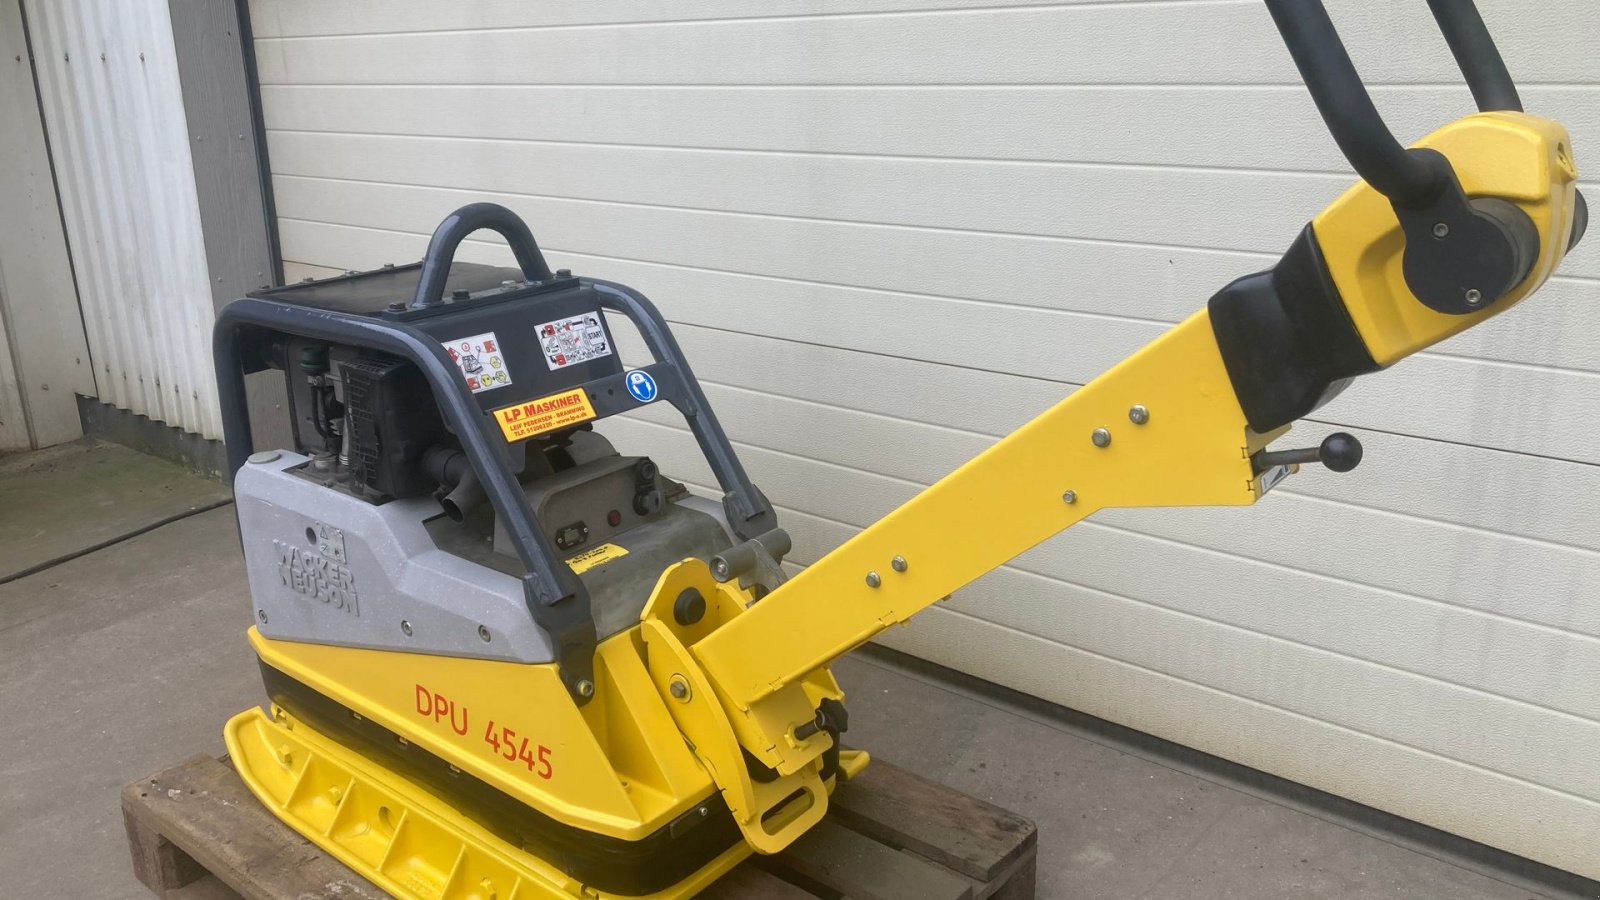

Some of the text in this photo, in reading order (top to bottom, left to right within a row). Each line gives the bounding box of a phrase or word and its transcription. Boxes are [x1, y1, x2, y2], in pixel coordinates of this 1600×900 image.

[587, 331, 603, 340] START
[504, 394, 581, 423] LP MASKINER
[510, 423, 522, 431] LEIF
[523, 415, 553, 428] PEDERSEN
[272, 538, 355, 591] WACKER
[279, 565, 360, 617] NEUSON
[416, 684, 552, 780] DPU 4545
